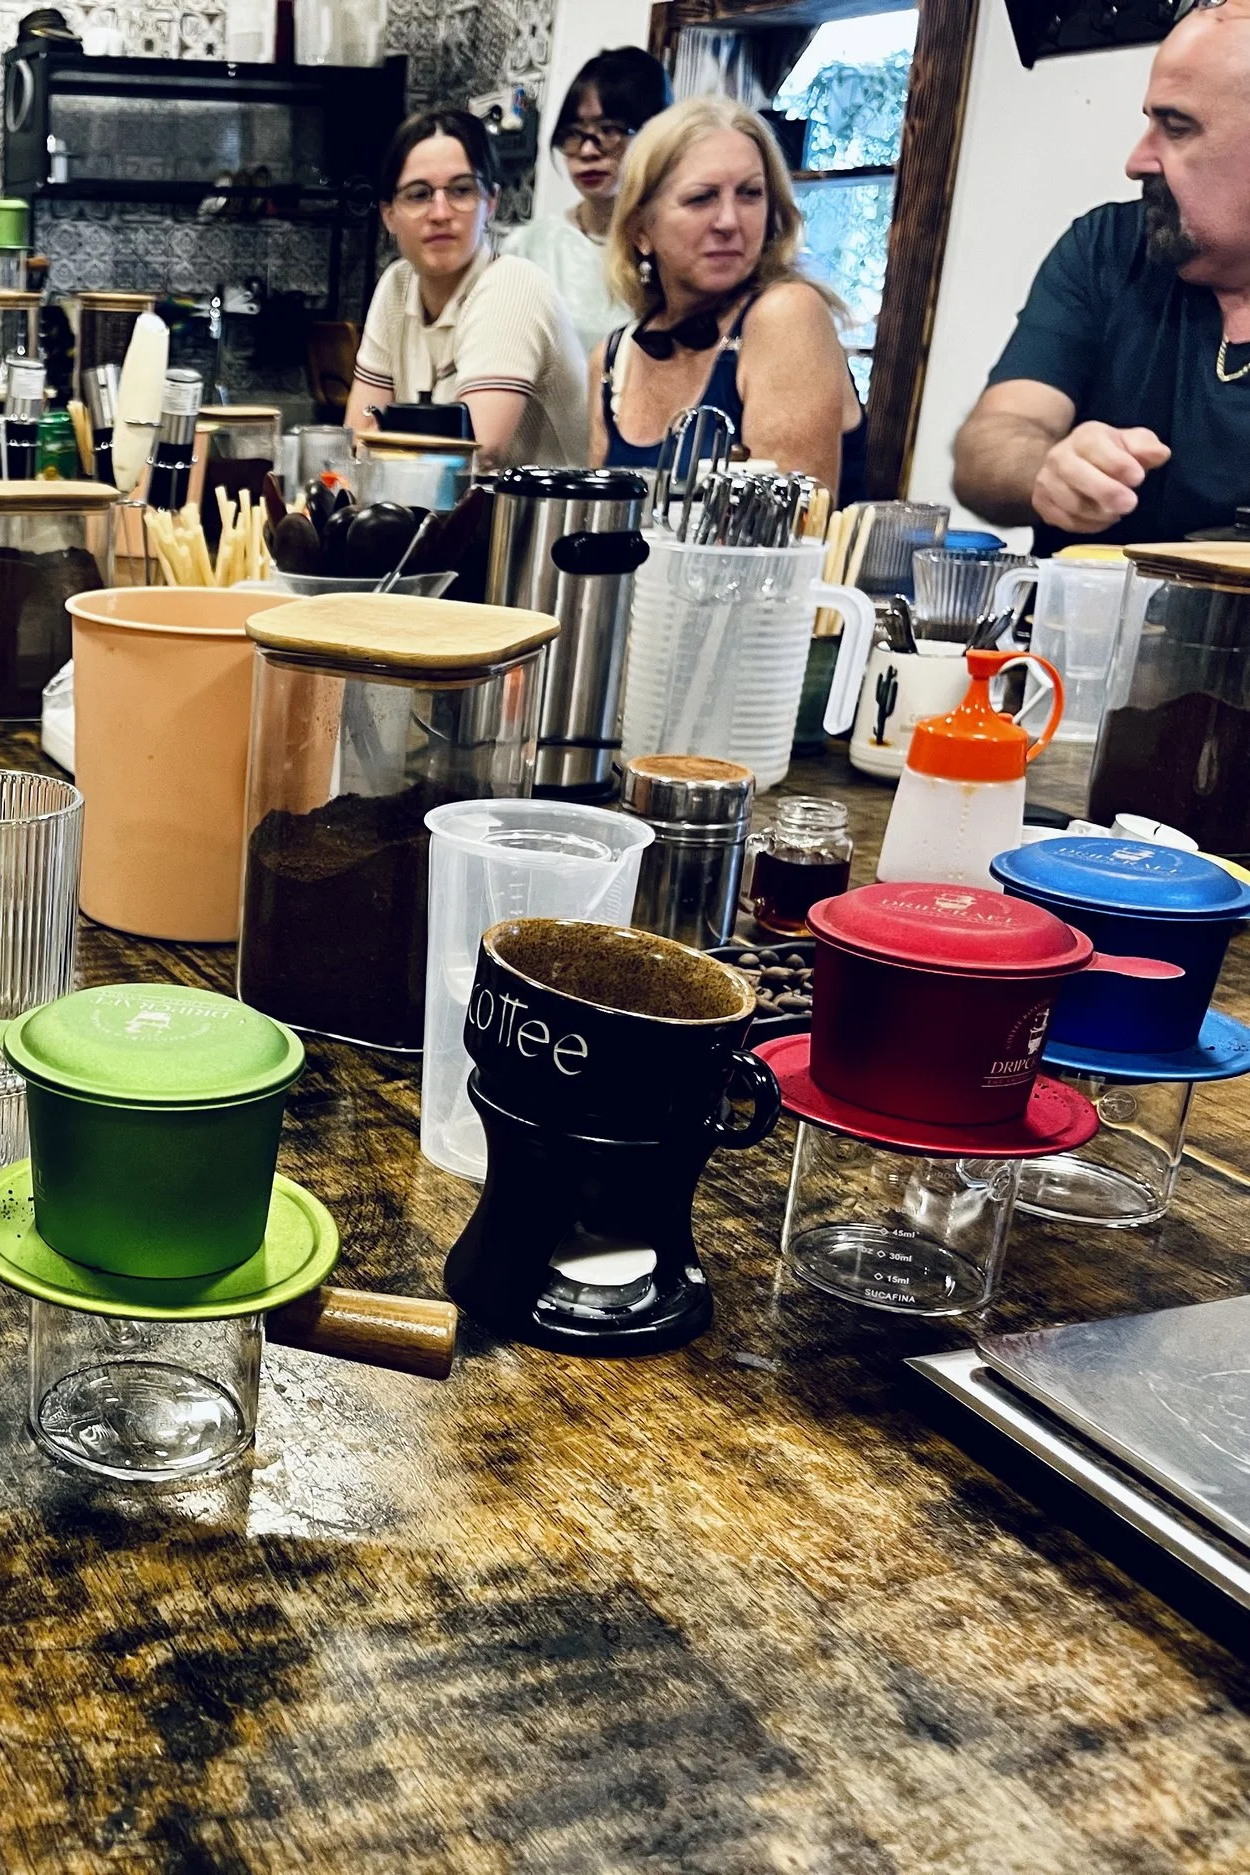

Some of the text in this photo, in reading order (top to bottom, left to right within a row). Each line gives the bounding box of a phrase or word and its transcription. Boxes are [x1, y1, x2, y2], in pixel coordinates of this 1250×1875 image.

[892, 1228, 916, 1239] 45ml
[889, 1252, 912, 1263] 30ml
[886, 1274, 910, 1285] 15ml
[864, 1288, 916, 1303] SUCAFINA
